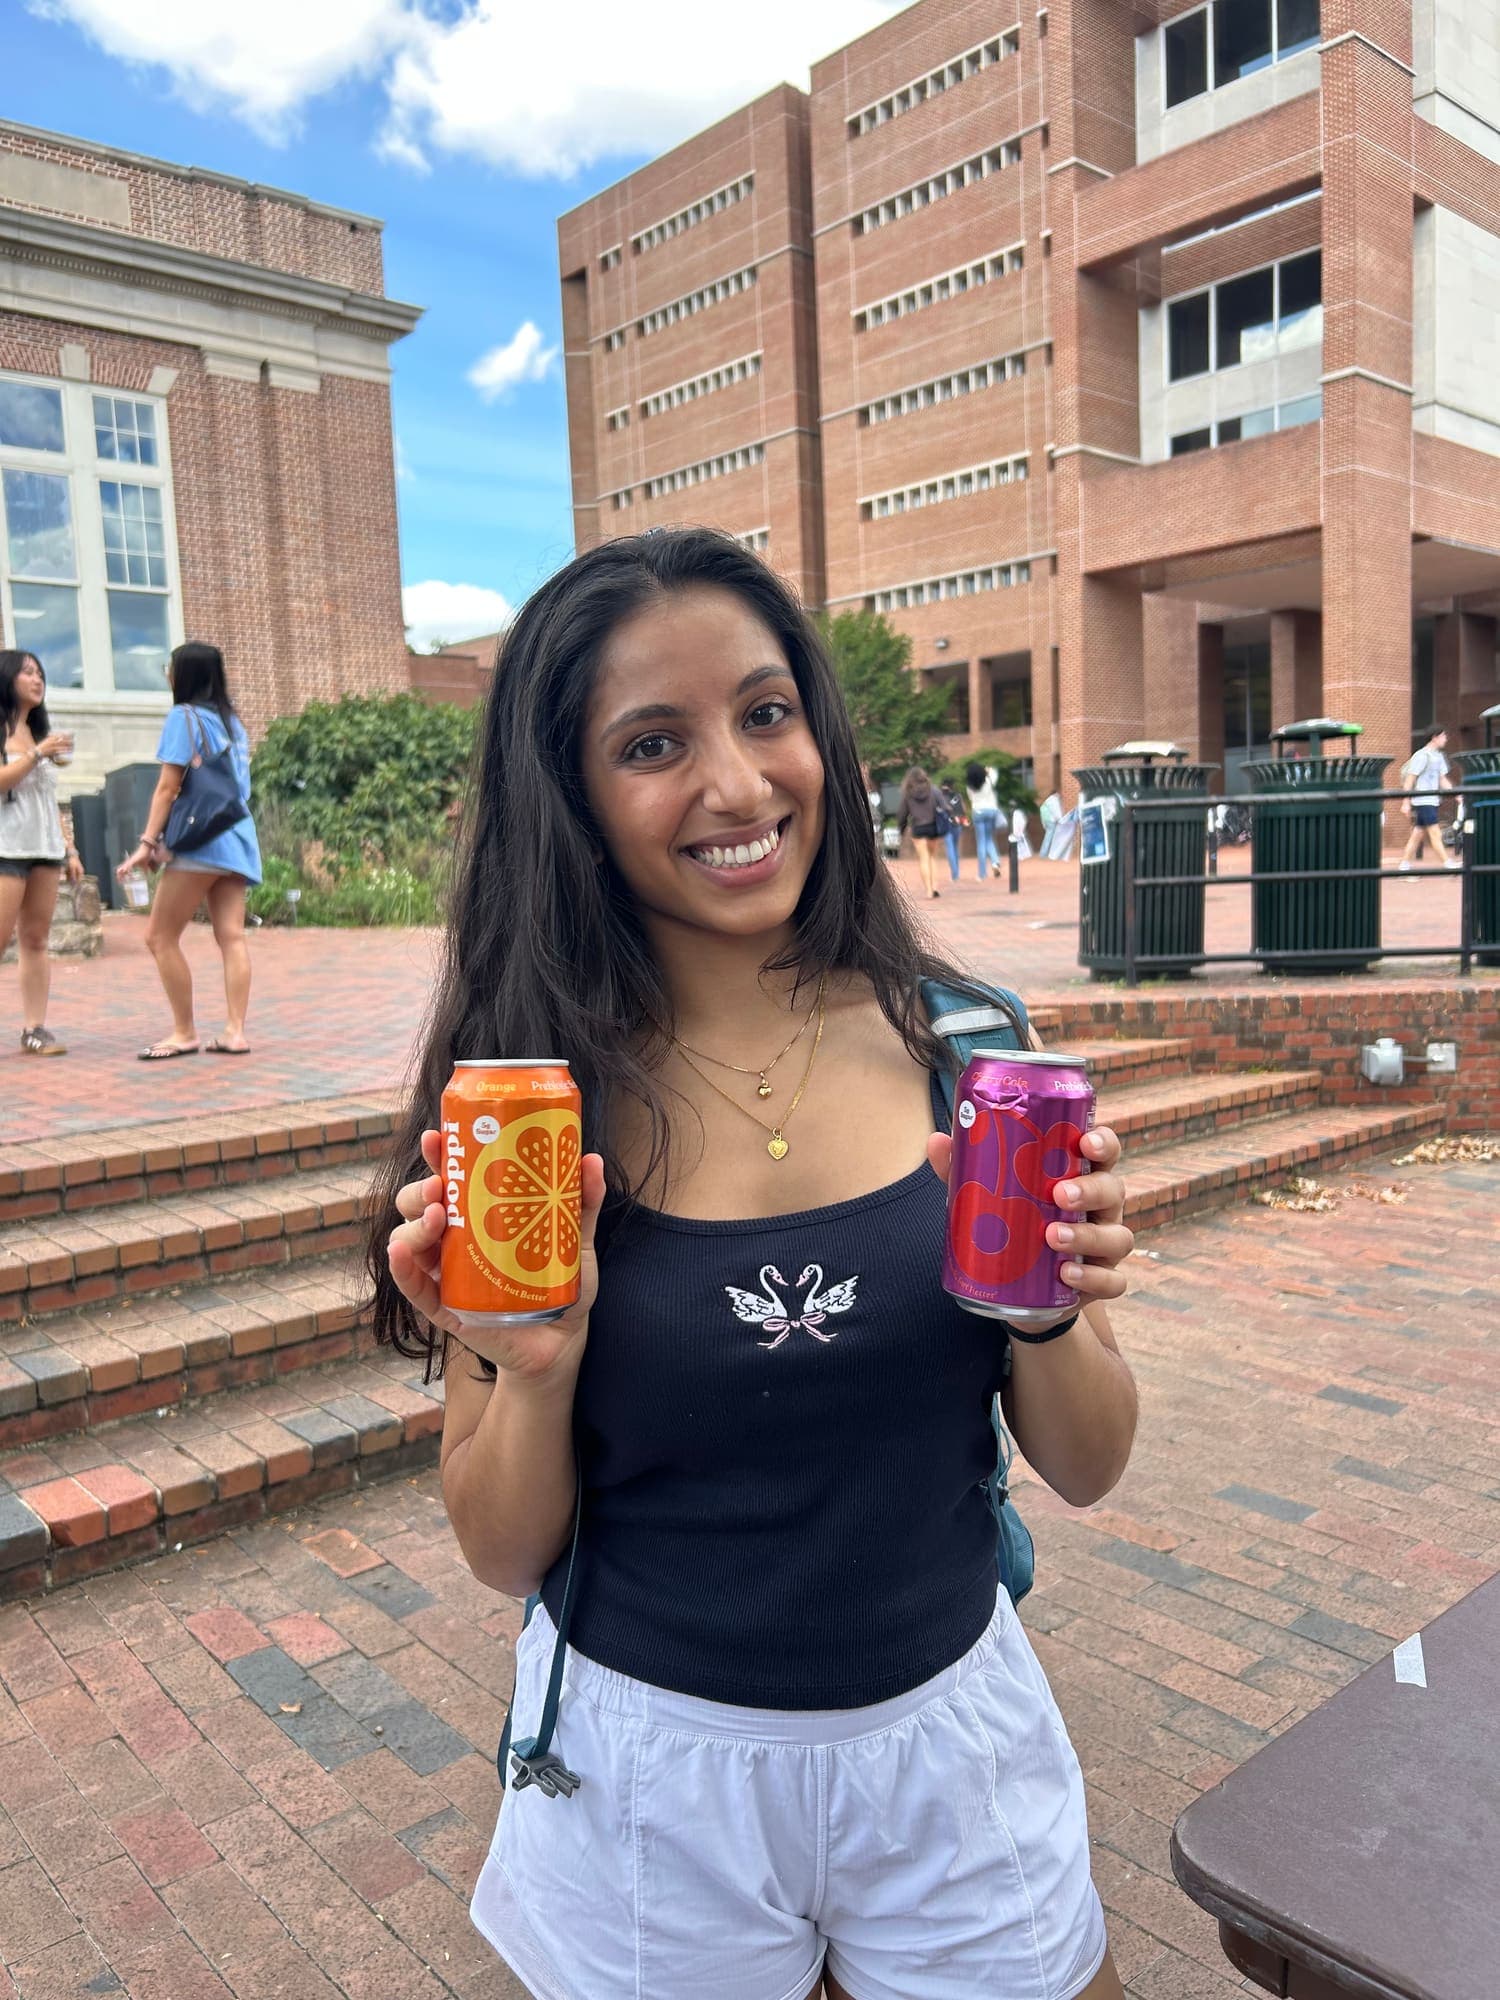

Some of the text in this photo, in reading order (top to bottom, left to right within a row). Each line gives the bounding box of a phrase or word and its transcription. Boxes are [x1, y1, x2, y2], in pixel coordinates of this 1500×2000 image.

[476, 1080, 517, 1093] Orange
[1003, 1075, 1028, 1089] Cola
[475, 1128, 497, 1136] Sugar
[481, 1121, 491, 1130] 5g
[443, 1122, 465, 1229] poppi
[466, 1243, 548, 1302] Soda's Back, but Better
